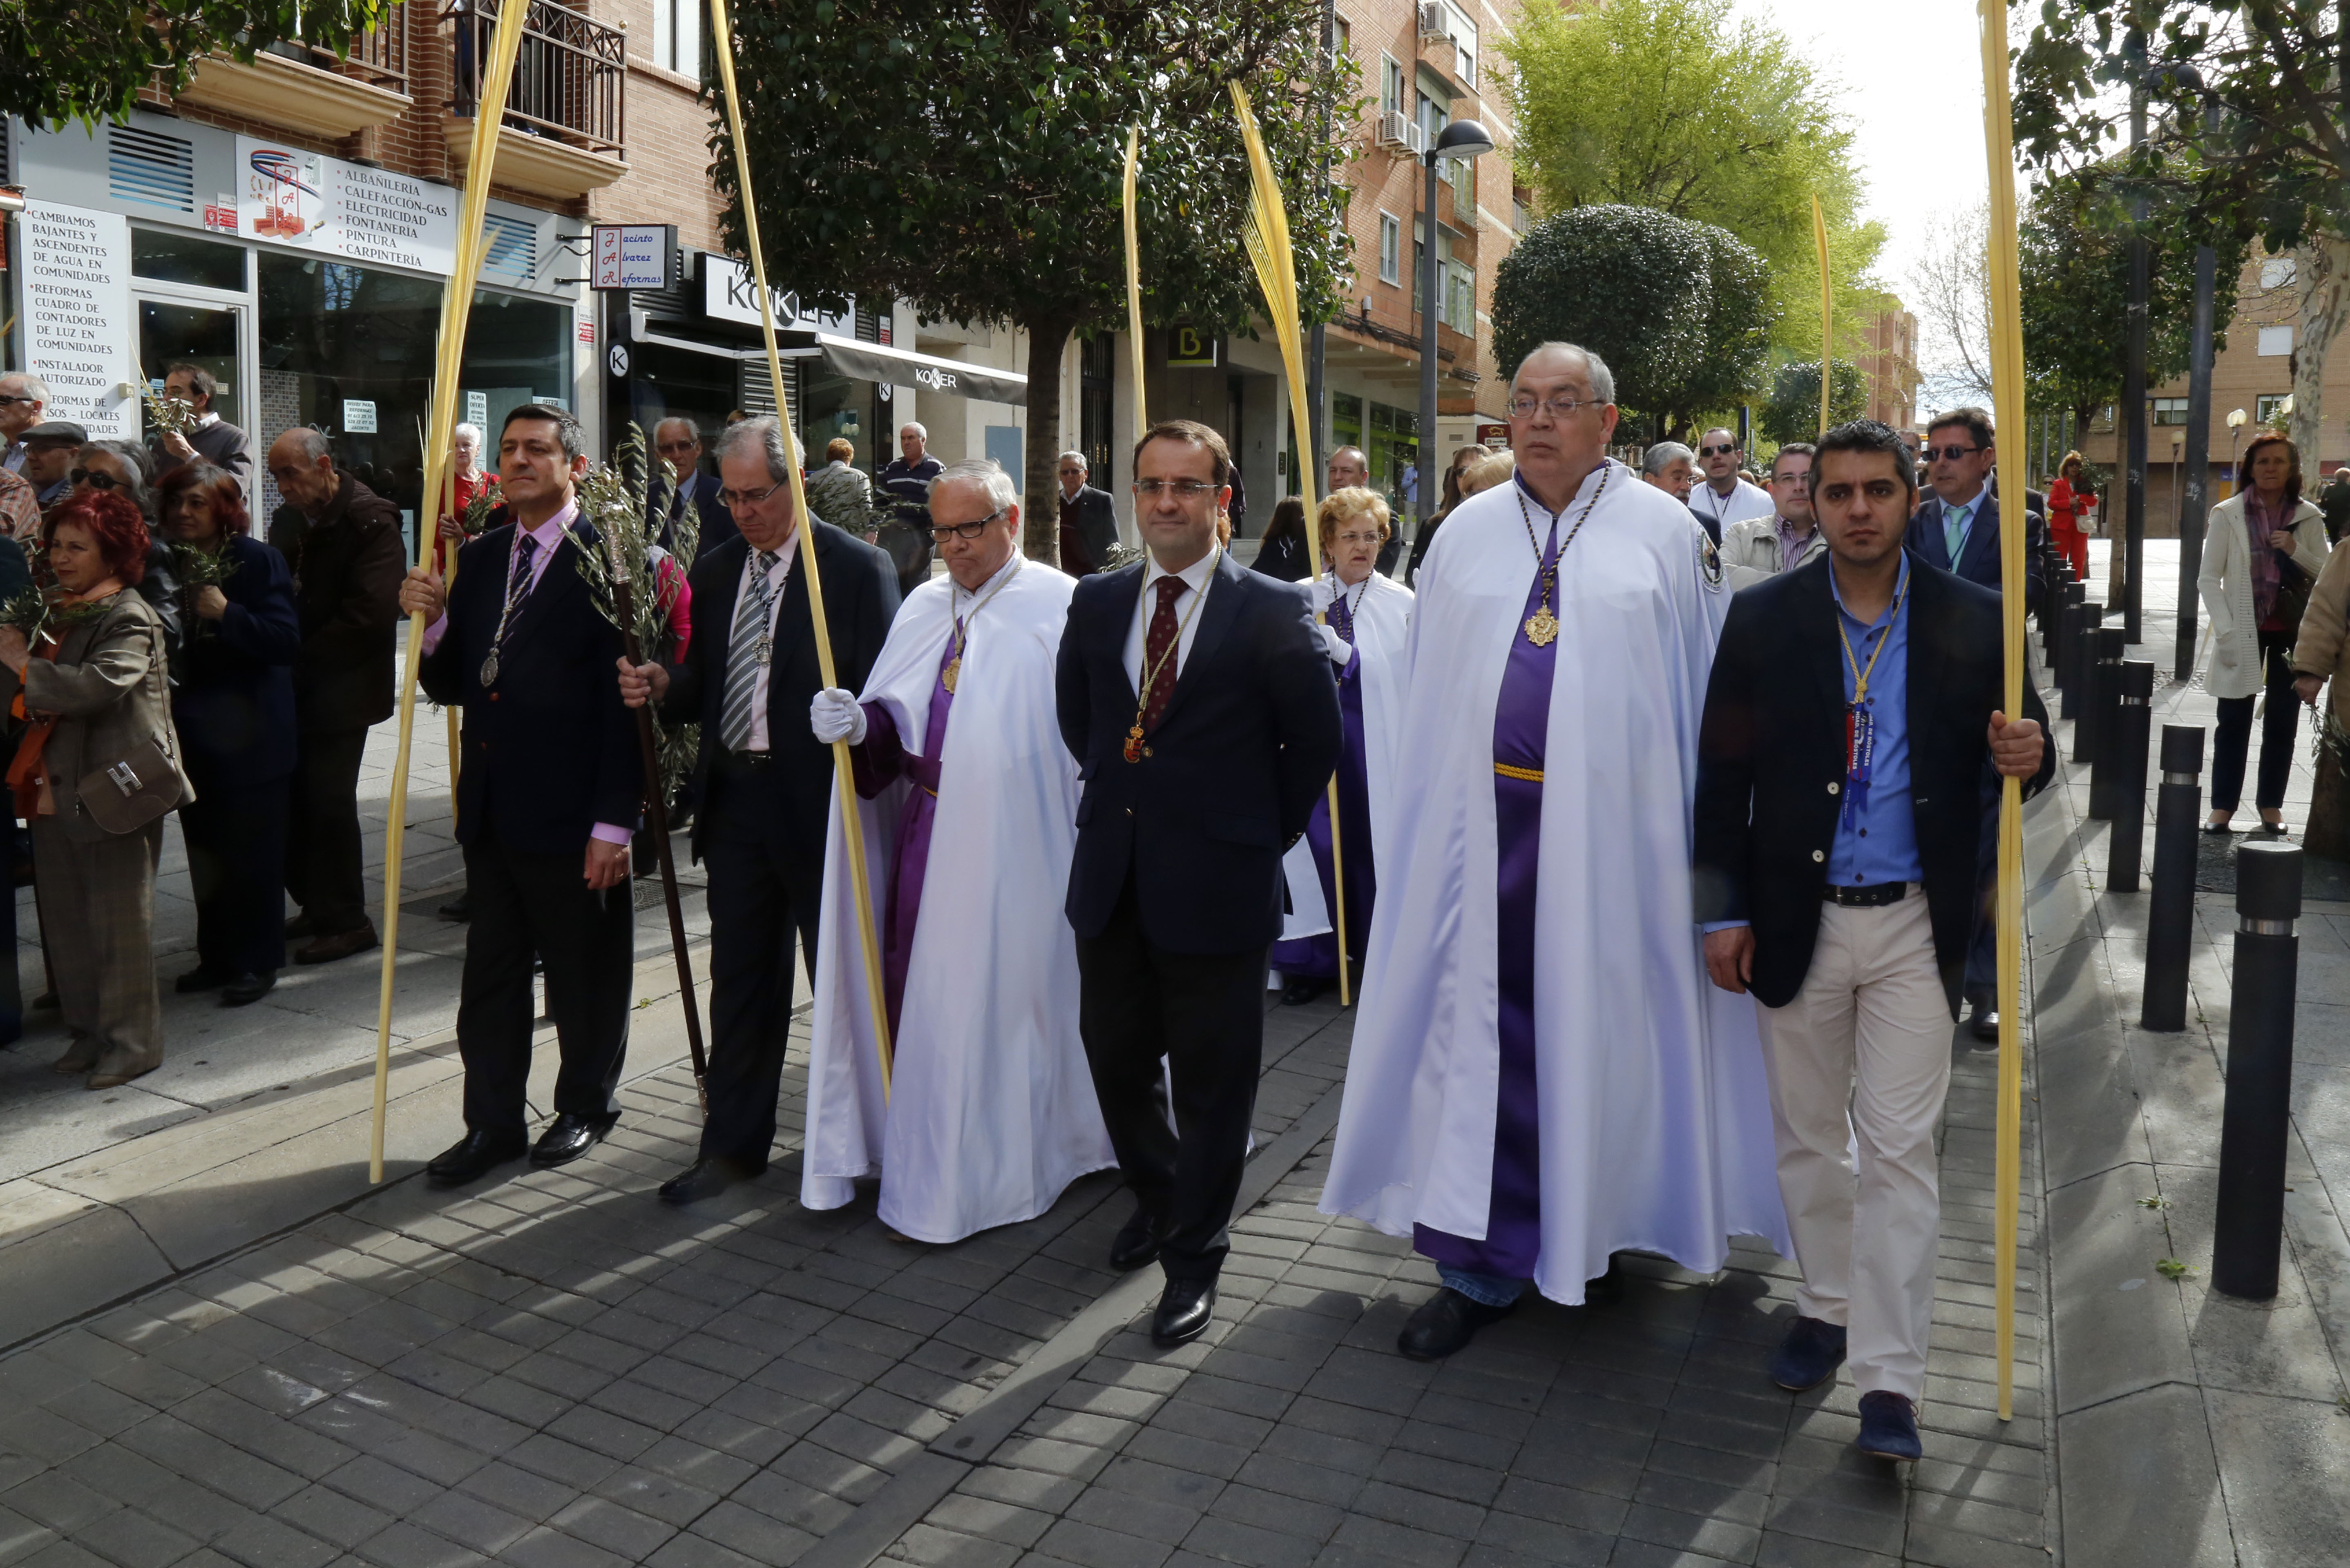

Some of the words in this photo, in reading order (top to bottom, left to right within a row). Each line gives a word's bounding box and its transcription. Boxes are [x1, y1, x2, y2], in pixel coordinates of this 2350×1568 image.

[345, 170, 420, 196] ALBAÑILERÍA
[31, 210, 96, 228] CAMBIAMOS
[346, 200, 427, 225] ELECTRICIDAD
[32, 224, 85, 240] BAJANTES
[90, 232, 97, 241] Y
[346, 214, 418, 238] FONTANERÍA
[33, 238, 107, 257] ASCENDENTES
[346, 230, 397, 248] PINTURA
[605, 232, 653, 247] Jacinto
[33, 252, 48, 261] DE
[54, 255, 83, 267] AGUA
[89, 259, 102, 269] EN
[346, 244, 422, 266] CARPINTERÍA
[34, 265, 110, 283] COMUNIDADES
[602, 271, 661, 287] Reformas
[34, 283, 92, 299] REFORMAS
[35, 298, 80, 310] CUADRO
[86, 303, 99, 313] DE
[36, 311, 107, 327] CONTADORES
[36, 325, 51, 335] DE
[56, 327, 76, 337] LUZ
[82, 330, 95, 339] EN
[37, 339, 112, 355] COMUNIDADES
[1180, 328, 1200, 355] B
[37, 359, 104, 373] INSTALADOR
[613, 352, 626, 370] K
[40, 373, 106, 386] AUTORIZADO
[916, 368, 957, 388] KOKER
[51, 395, 90, 406] FORMAS
[95, 398, 107, 407] DE
[47, 409, 67, 418] ISOS
[80, 410, 120, 420] LOCALES
